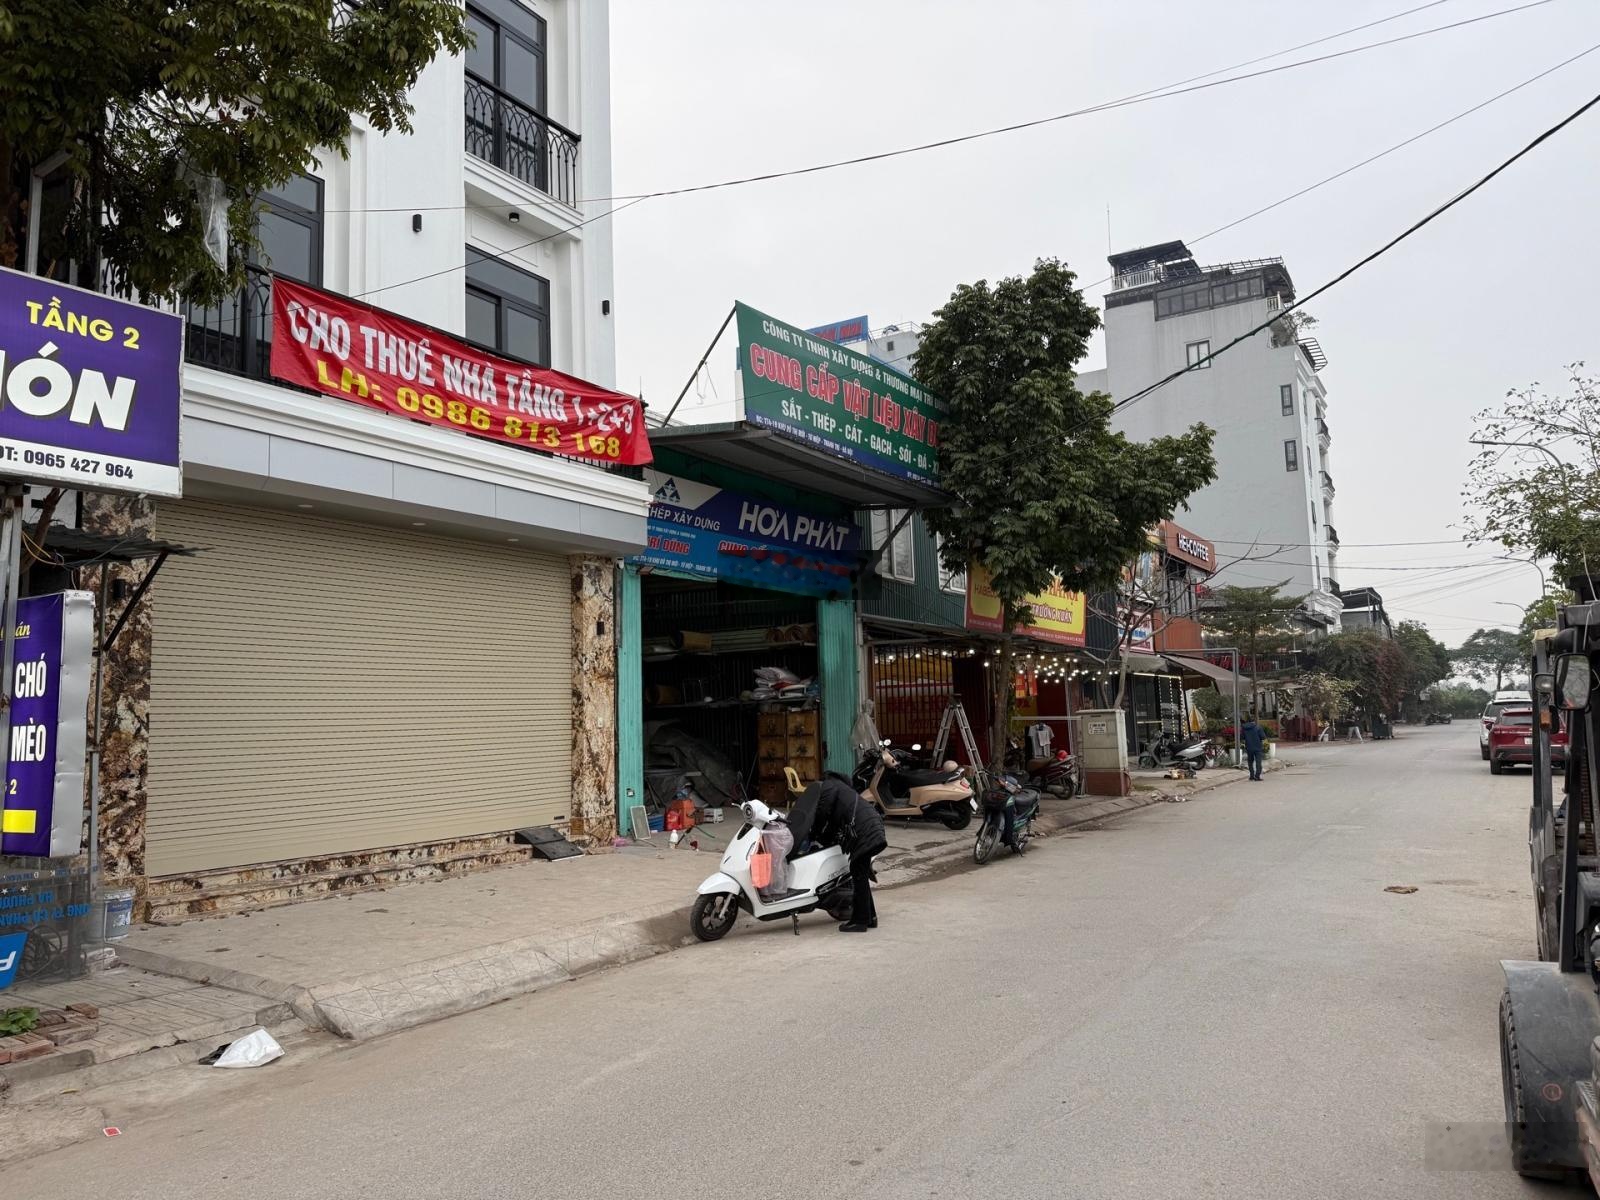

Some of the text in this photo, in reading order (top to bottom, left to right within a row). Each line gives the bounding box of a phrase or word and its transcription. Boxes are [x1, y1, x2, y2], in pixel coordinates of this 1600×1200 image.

[26, 296, 140, 350] TẦNG 2
[0, 341, 136, 431] ÓN
[285, 300, 351, 361] CHO
[360, 323, 435, 387] THUÊ
[441, 354, 499, 411] NHÀ
[505, 368, 568, 423] TẦNG
[763, 320, 790, 343] CÔNG
[791, 333, 803, 348] TY
[805, 338, 830, 360] TNHH
[831, 349, 848, 367] XÂY
[850, 357, 874, 377] DỰNG
[875, 368, 881, 381] &
[882, 371, 909, 395] THƯƠNG
[910, 385, 922, 403] MẠI
[317, 359, 620, 458] LH: 0986 813 168
[750, 342, 802, 392] CUNG
[806, 361, 839, 405] CẤP
[843, 378, 870, 421] VẬT
[872, 393, 900, 434] LIỆU
[903, 406, 926, 443] XÂY
[781, 397, 802, 421] SẮT
[811, 409, 836, 433] THÉP
[845, 424, 863, 443] CÁT
[870, 434, 892, 456] GẠCH
[899, 444, 912, 464] SỎI
[23, 449, 65, 469] 0965
[70, 457, 100, 474] 427
[105, 462, 133, 479] 964
[649, 506, 721, 531] HÉP XÂY DỰNG
[792, 515, 850, 551] PHÁT
[14, 653, 47, 699] CHÓ
[10, 717, 47, 762] MÈO
[9, 779, 17, 795] 2
